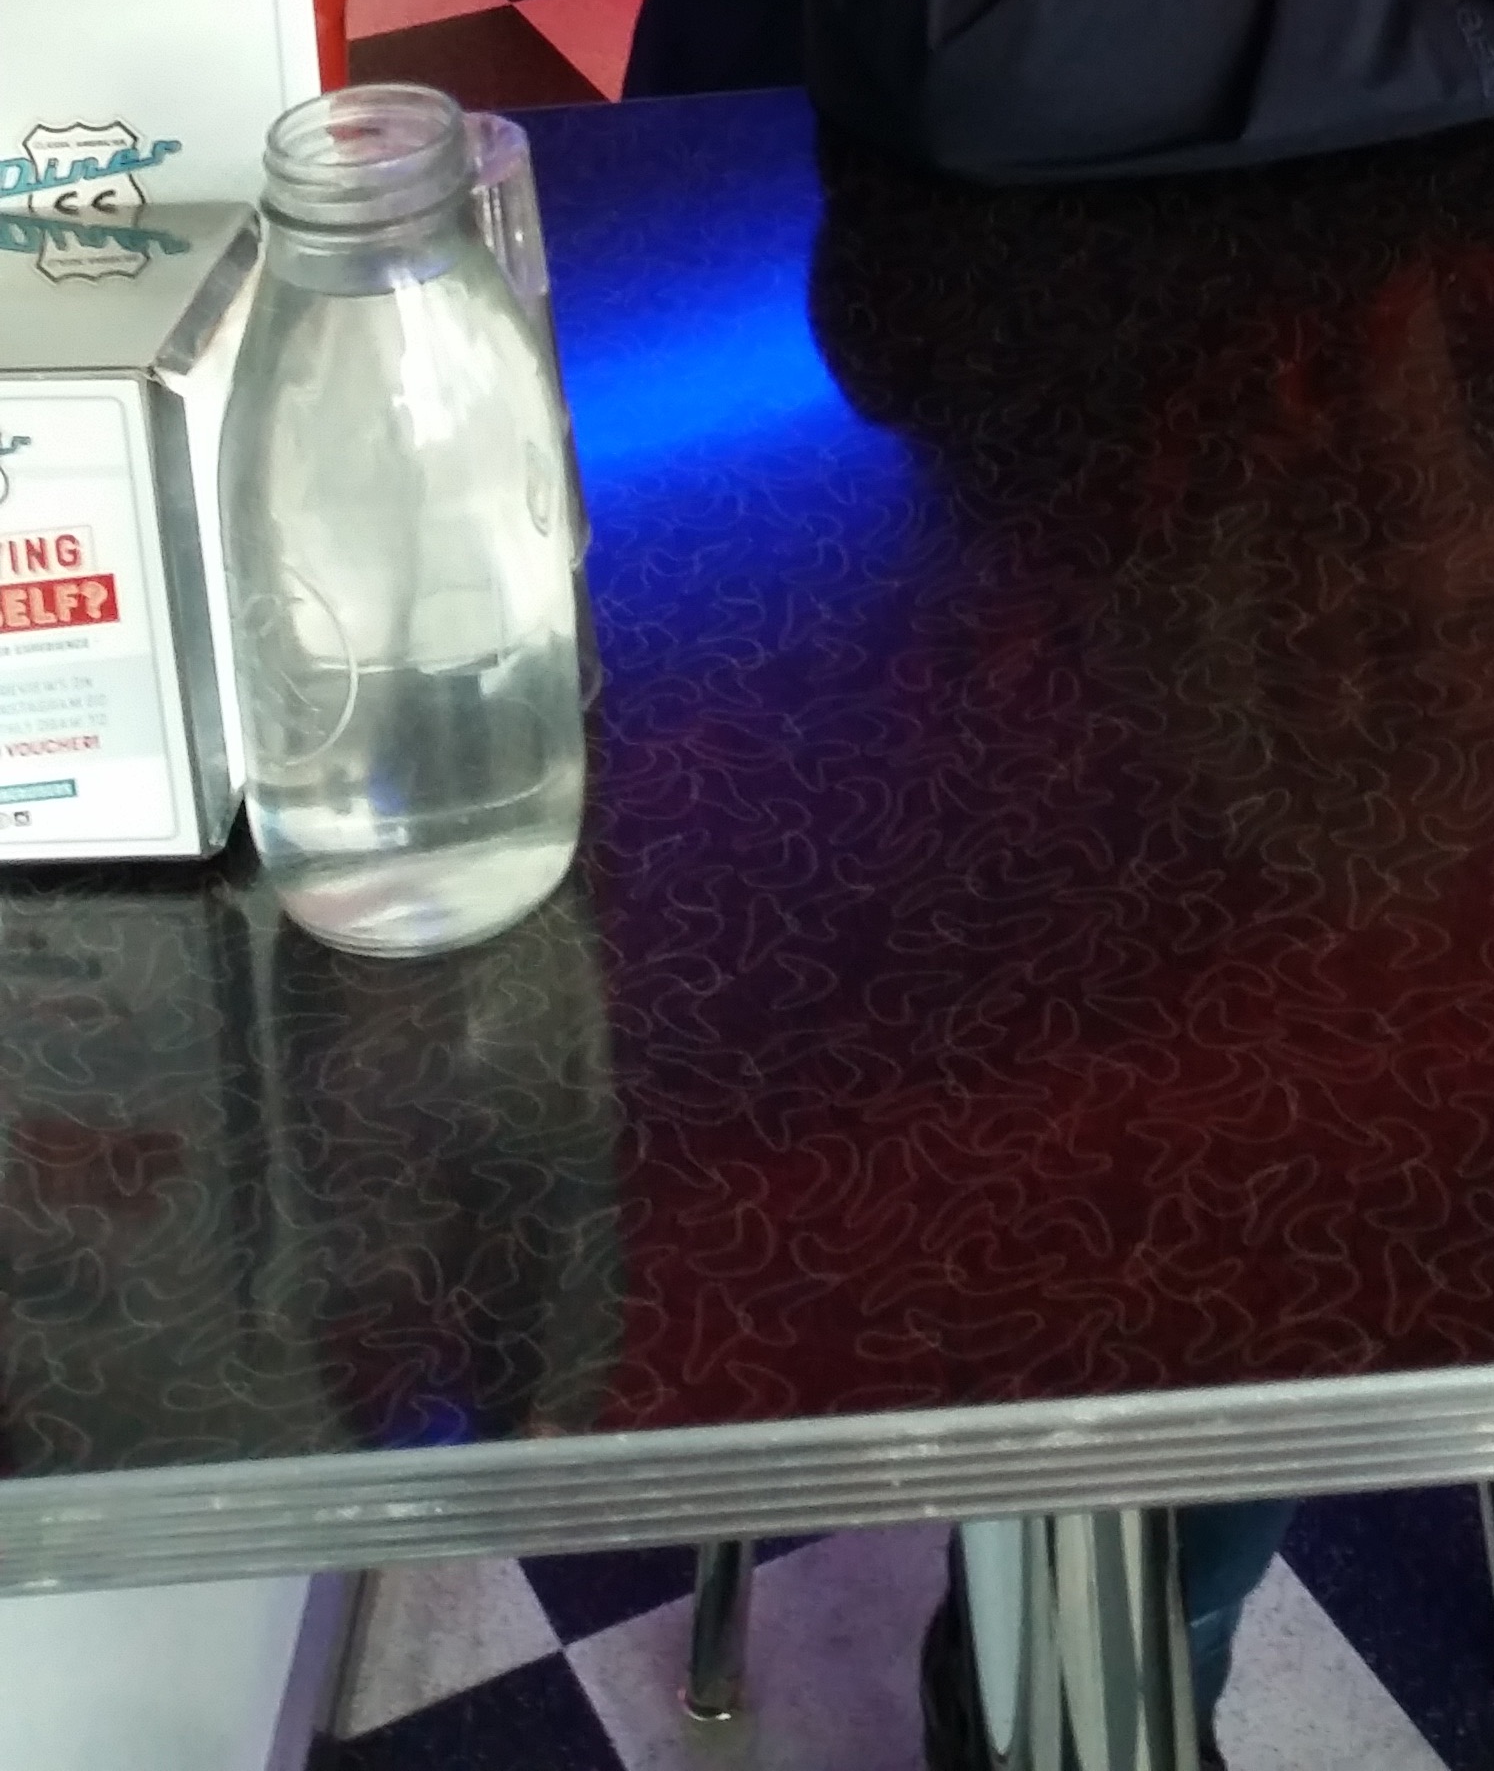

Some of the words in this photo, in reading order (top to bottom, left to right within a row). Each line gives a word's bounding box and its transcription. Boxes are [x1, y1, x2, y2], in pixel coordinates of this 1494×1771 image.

[0, 139, 183, 198] Diner
[0, 533, 82, 575] ING
[0, 579, 108, 627] ELF?
